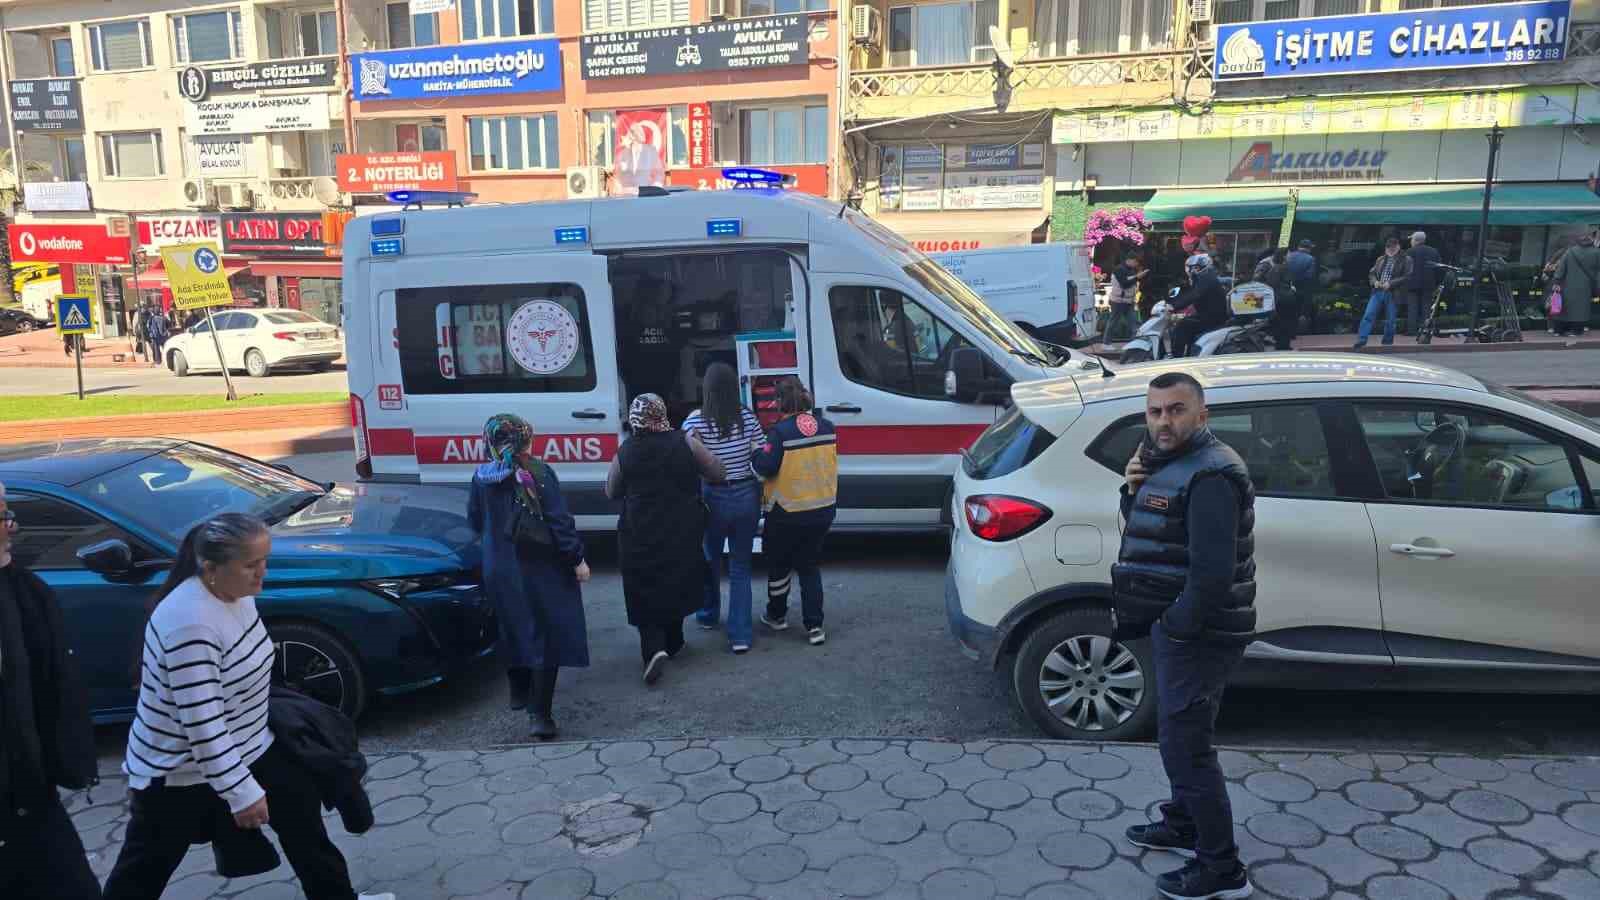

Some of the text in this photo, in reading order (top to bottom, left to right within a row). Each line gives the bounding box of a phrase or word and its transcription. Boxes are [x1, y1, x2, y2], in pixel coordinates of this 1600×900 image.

[635, 28, 679, 39] HUKUK
[734, 29, 783, 44] AVUKAT
[1275, 16, 1566, 66] İŞİTME CİHAZLARI
[593, 42, 639, 55] AVUKAT
[1527, 49, 1541, 60] 92
[389, 48, 545, 79] uzunmehmetoğlu
[262, 64, 326, 79] GÜZELLİK
[200, 142, 240, 155] AVUKAT
[692, 119, 703, 165] NOTER
[348, 162, 444, 182] 2. NOTERLİĞİ
[152, 219, 218, 238] ECZANE
[284, 218, 322, 240] OPT
[37, 236, 84, 250] vodafone
[380, 387, 399, 400] 112
[442, 437, 603, 462] AMANS
